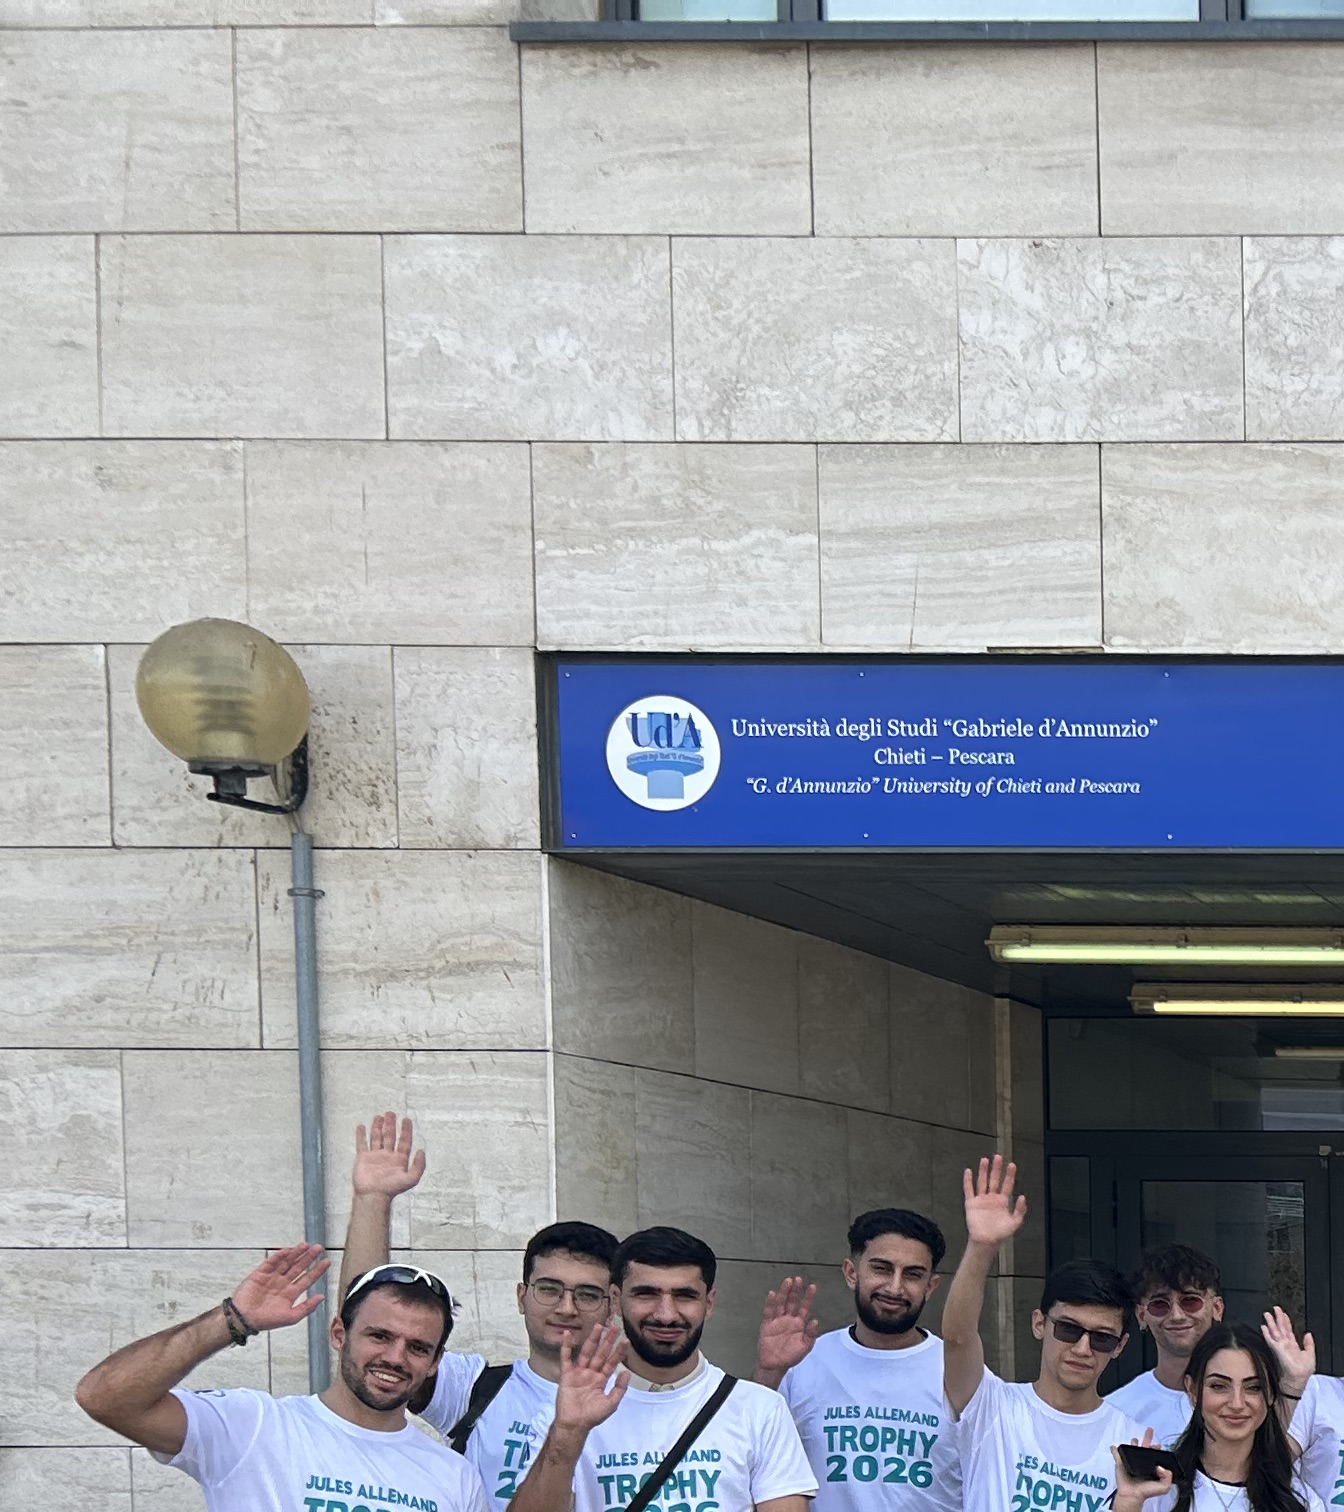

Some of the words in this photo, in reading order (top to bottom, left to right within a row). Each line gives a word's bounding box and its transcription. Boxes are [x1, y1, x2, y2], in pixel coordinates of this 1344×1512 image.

[731, 717, 832, 738] Università
[835, 717, 883, 742] degli
[887, 717, 938, 737] Studi
[874, 747, 926, 765] Chieti
[948, 748, 1016, 765] Pescara
[883, 777, 972, 798] University
[975, 776, 995, 798] of
[996, 777, 1042, 795] Chieti
[1044, 777, 1076, 794] and
[1079, 778, 1141, 794] Pescara
[824, 1406, 860, 1421] JULES
[864, 1407, 939, 1428] ALLEMAND
[823, 1425, 938, 1459] TROPHY
[596, 1452, 638, 1469] JULES
[826, 1455, 933, 1489] 2026
[306, 1475, 353, 1494] JULES
